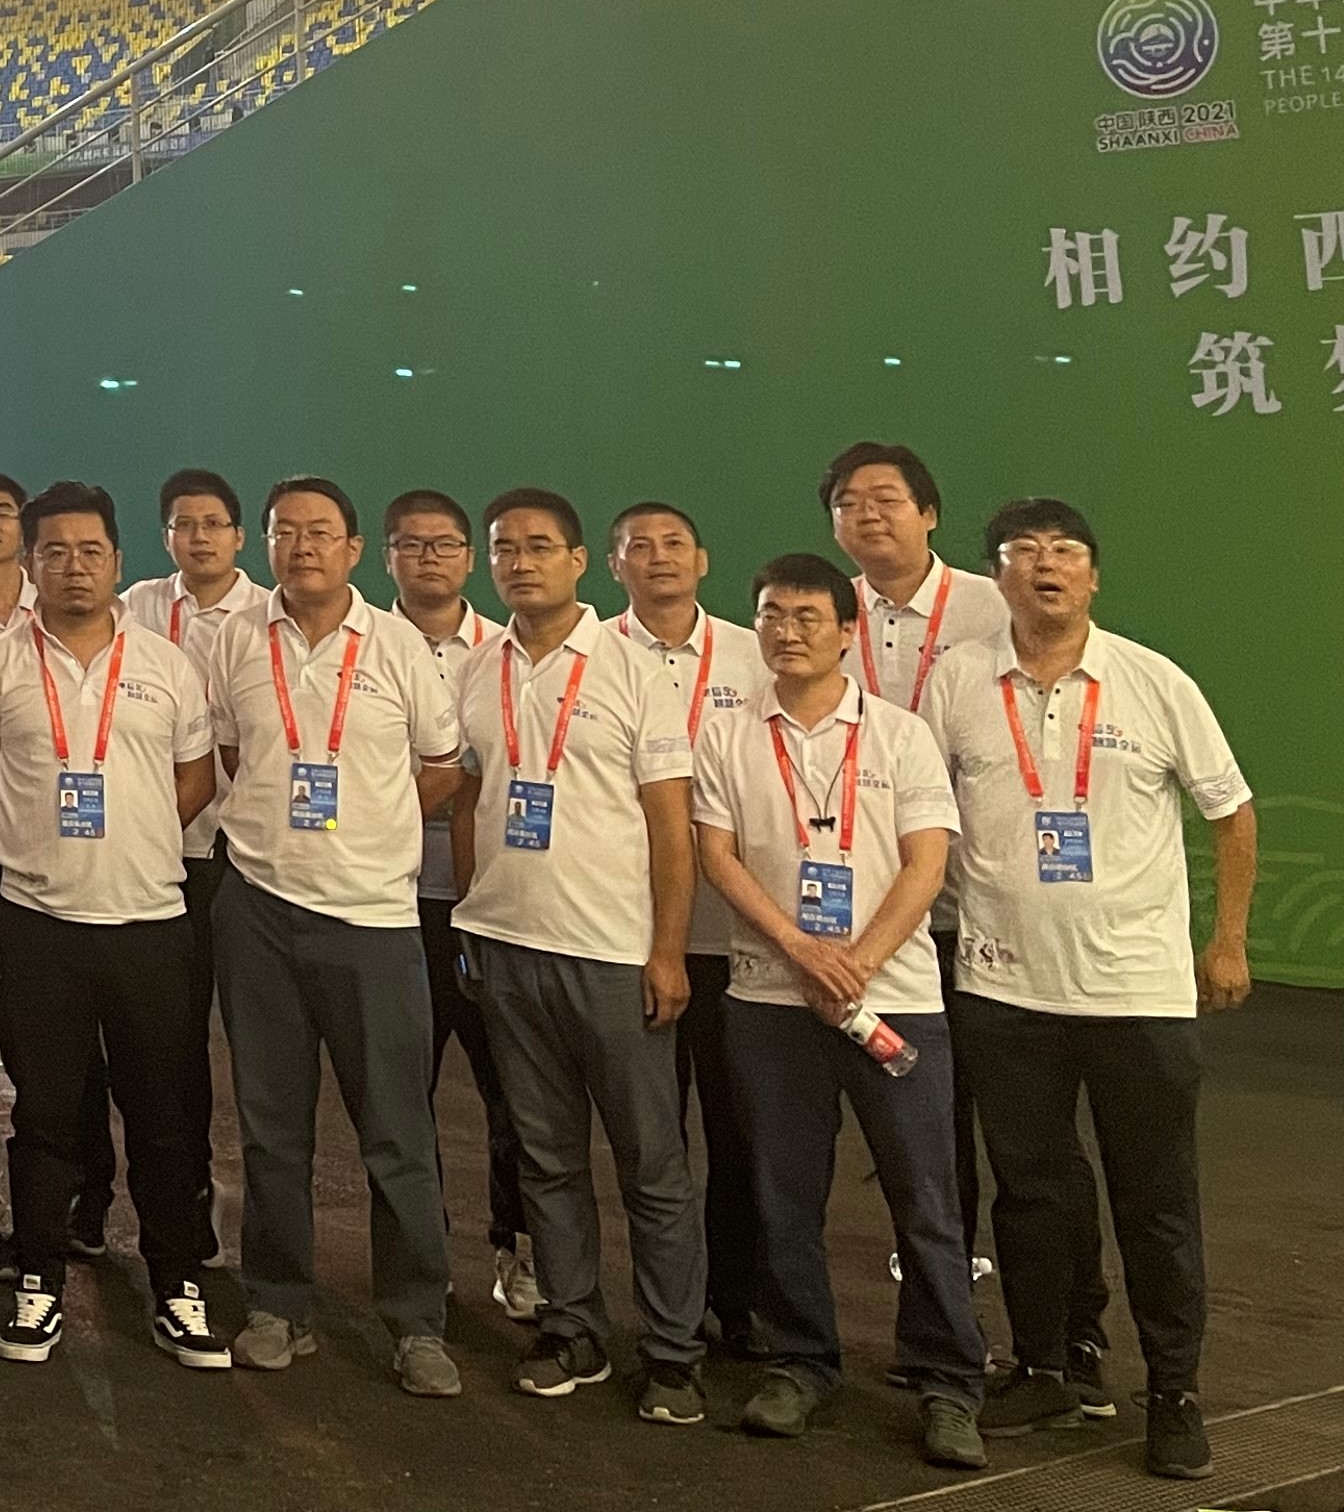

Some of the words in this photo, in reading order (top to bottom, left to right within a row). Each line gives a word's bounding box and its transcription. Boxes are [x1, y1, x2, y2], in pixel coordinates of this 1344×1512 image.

[1258, 16, 1342, 61] 第十
[1260, 65, 1315, 89] THE
[1183, 101, 1236, 124] 2021
[1098, 131, 1179, 151] SHAANXI
[1183, 123, 1238, 142] CHINA
[1187, 324, 1344, 417] 筑
